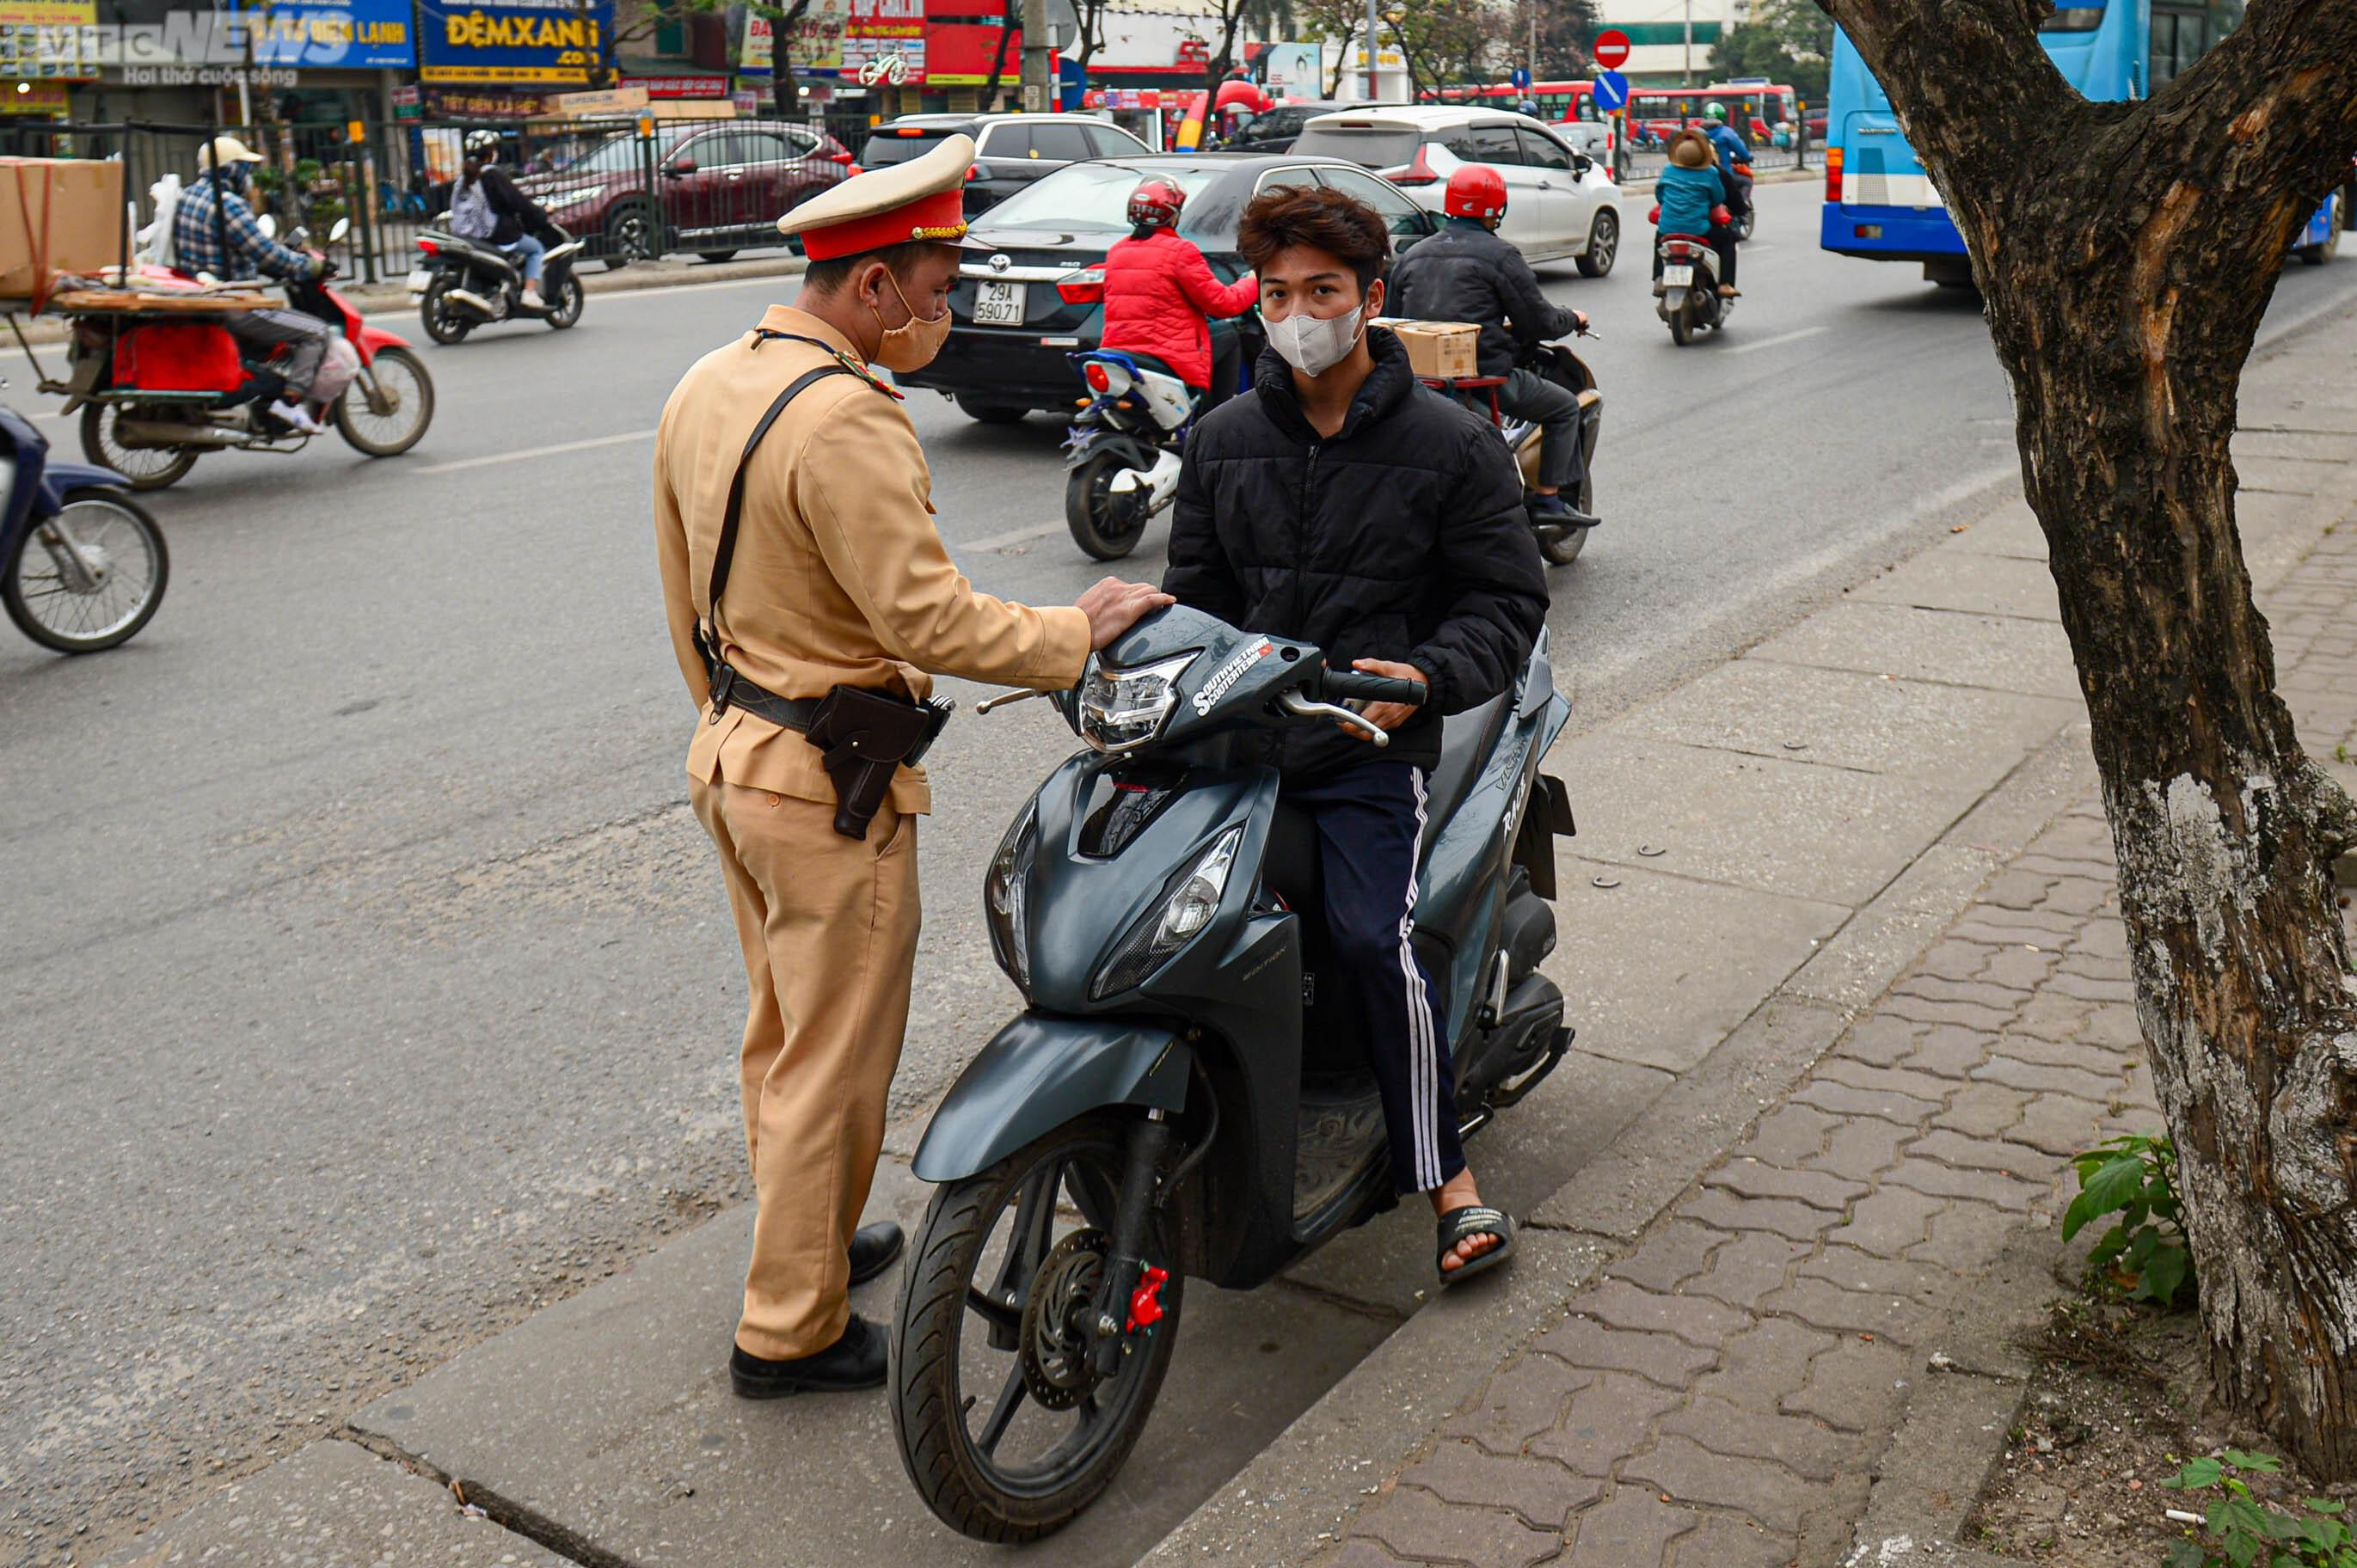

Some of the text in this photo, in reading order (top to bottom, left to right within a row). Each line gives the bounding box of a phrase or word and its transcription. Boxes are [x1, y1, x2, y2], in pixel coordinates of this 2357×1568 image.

[989, 285, 1013, 302] 29A
[977, 303, 1020, 322] 590.71
[1495, 734, 1529, 791] VISION
